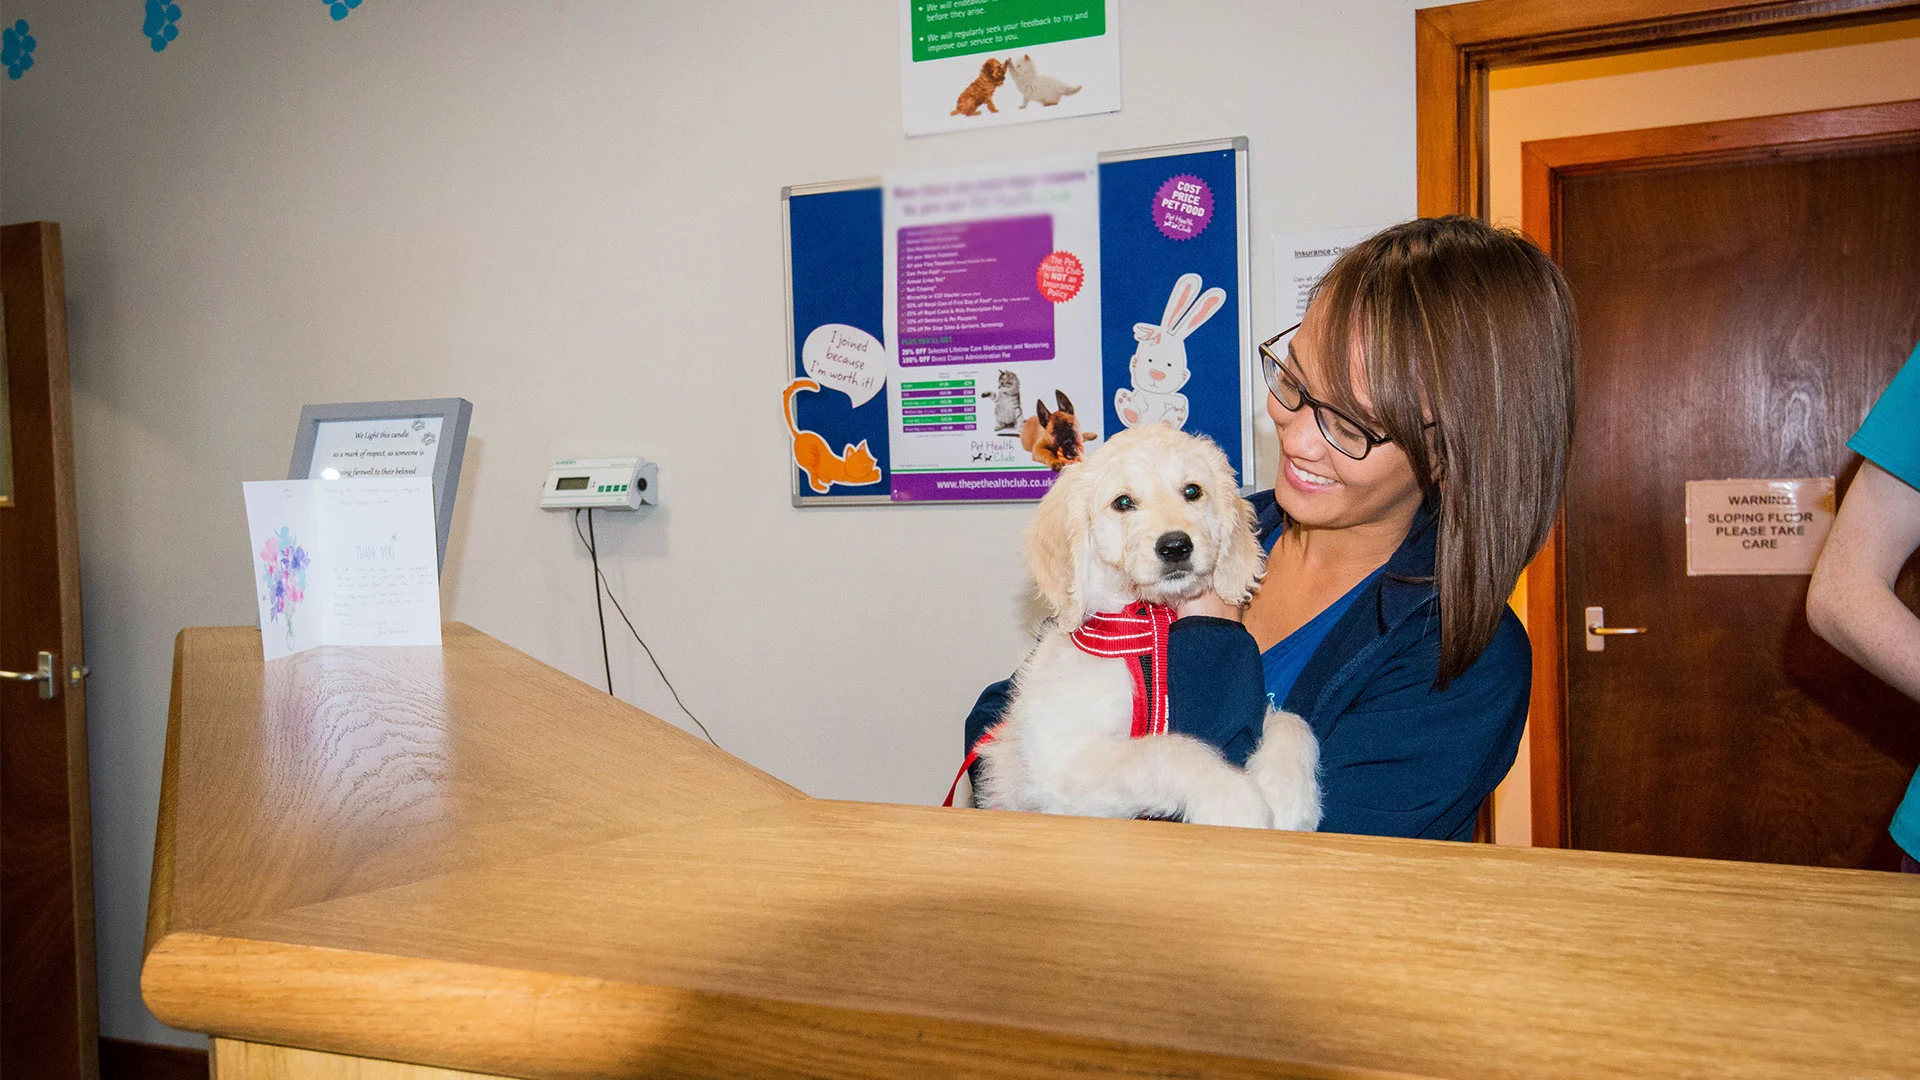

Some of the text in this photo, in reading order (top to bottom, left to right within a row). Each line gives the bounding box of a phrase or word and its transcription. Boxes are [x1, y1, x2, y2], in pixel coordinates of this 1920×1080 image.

[927, 4, 938, 12] We
[940, 1, 952, 10] will
[927, 14, 948, 22] before
[967, 8, 986, 16] arise.
[941, 31, 953, 40] will
[955, 28, 984, 39] regularly
[986, 25, 1001, 34] seek
[1003, 23, 1018, 32] your
[1020, 17, 1051, 28] feedback
[1075, 11, 1088, 20] and
[928, 43, 955, 53] improve
[970, 38, 993, 46] service
[1178, 181, 1202, 195] COST
[1172, 190, 1200, 206] PRICE
[1162, 198, 1205, 217] PET FOOD
[1294, 250, 1331, 258] Insurance
[1051, 255, 1076, 267] The Pet
[1042, 263, 1081, 276] Health Club
[1044, 272, 1050, 280] is
[1051, 272, 1067, 282] NOT
[1043, 280, 1075, 291] Insurance
[1047, 288, 1068, 299] Policy
[832, 330, 869, 352] I joined
[902, 348, 915, 356] 20%
[826, 346, 865, 370] because
[810, 360, 875, 388] I'm worth it!
[365, 431, 380, 441] Light
[391, 430, 409, 438] candle
[971, 440, 1015, 451] Pet Health
[360, 450, 366, 459] of
[994, 451, 1015, 462] Club
[352, 468, 374, 477] farewell
[395, 467, 416, 475] beloved
[1728, 496, 1791, 506] WARNING
[1708, 512, 1813, 524] SLOPING FLOOR
[1716, 526, 1805, 536] PLEASE TAKE
[1742, 539, 1778, 549] CARE
[356, 545, 396, 560] THANK YOU
